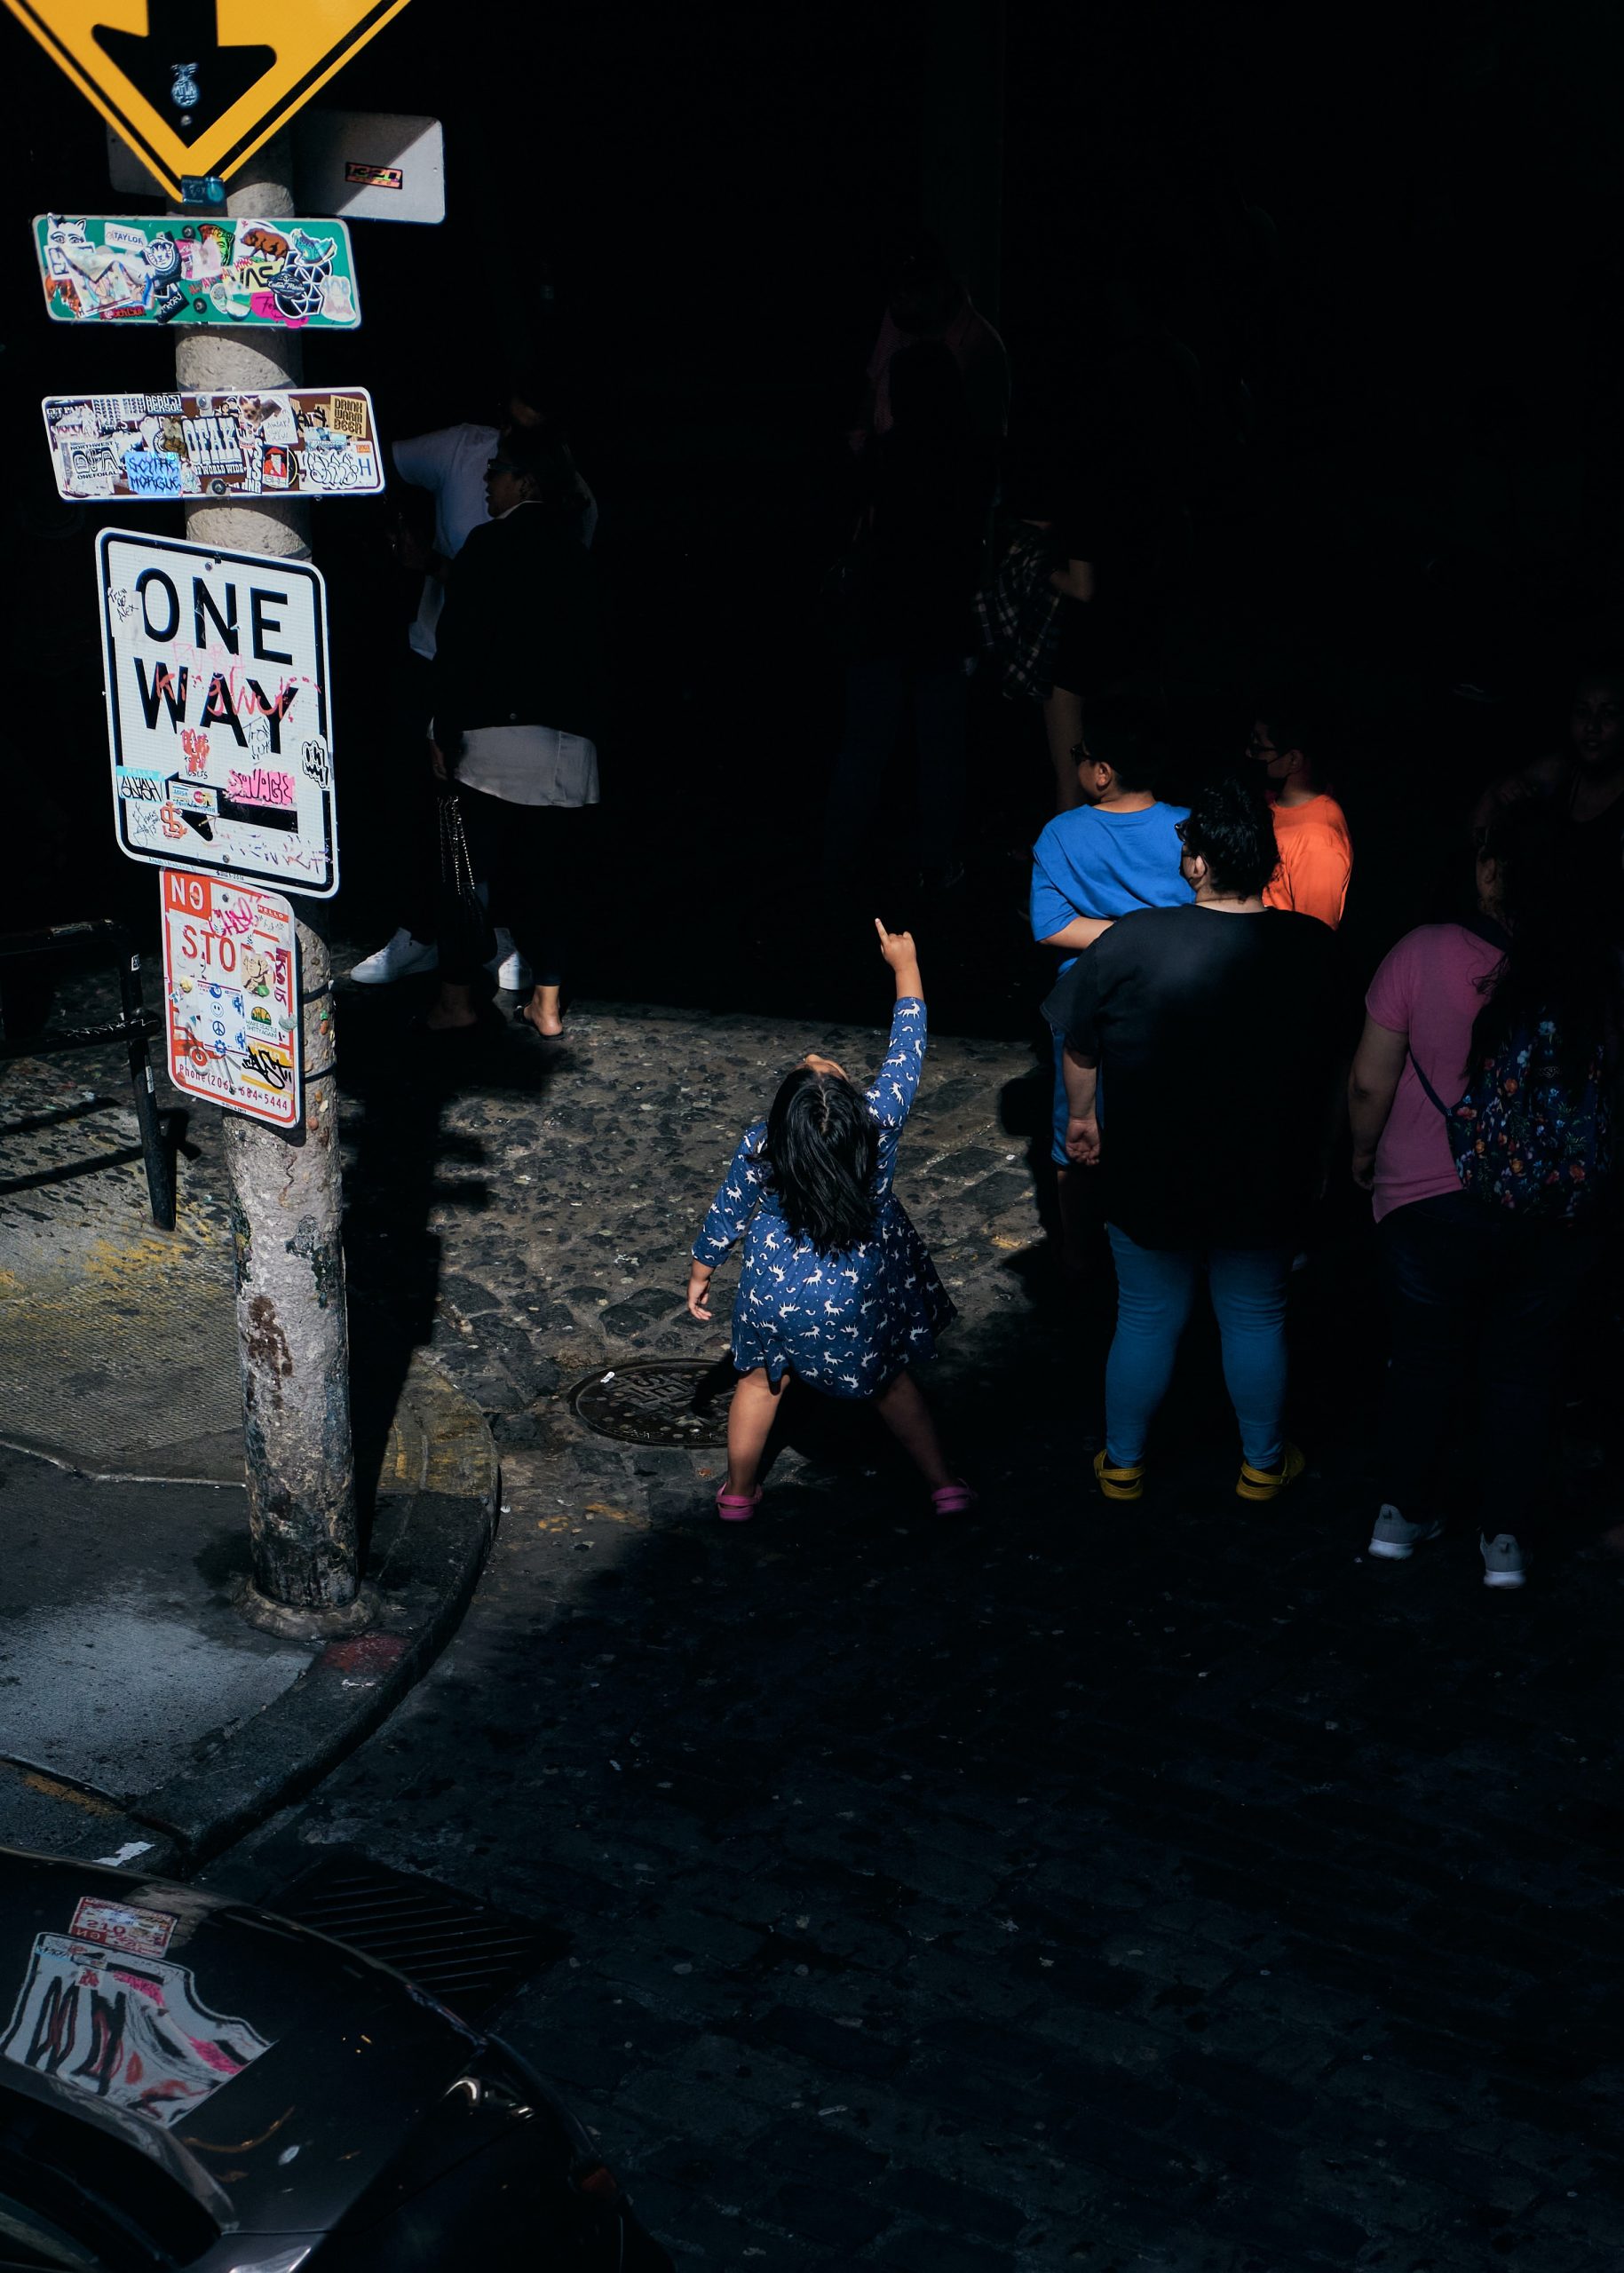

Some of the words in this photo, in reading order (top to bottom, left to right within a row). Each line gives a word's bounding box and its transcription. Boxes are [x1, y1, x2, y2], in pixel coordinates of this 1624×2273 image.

[71, 440, 114, 451] NORTHWEST
[135, 566, 293, 666] ONE
[133, 656, 299, 755] WAY
[170, 874, 204, 911] NO
[179, 1064, 207, 1083] Phone
